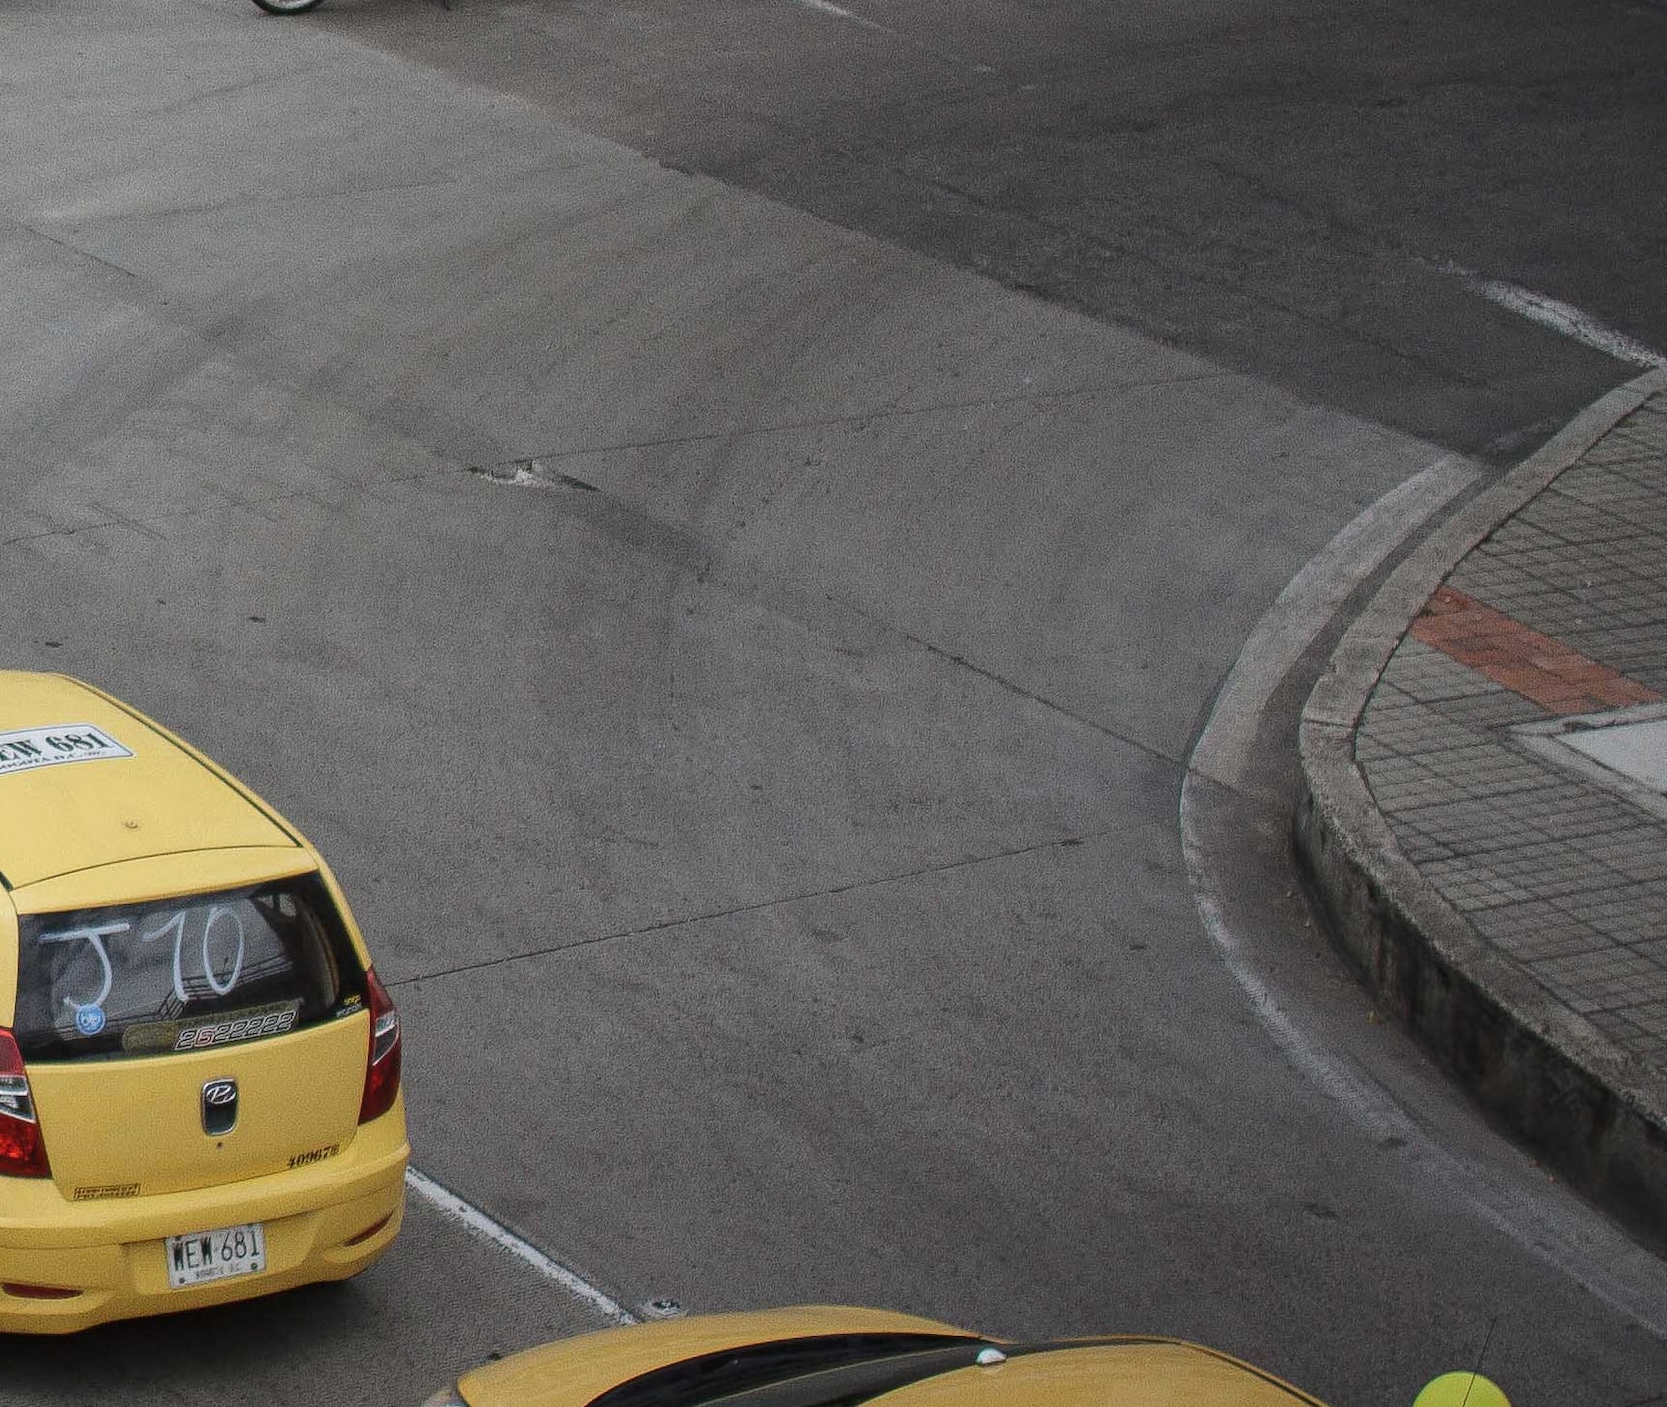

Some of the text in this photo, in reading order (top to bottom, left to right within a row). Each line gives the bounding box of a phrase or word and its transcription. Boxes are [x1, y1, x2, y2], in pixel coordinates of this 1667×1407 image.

[44, 732, 115, 754] 681
[39, 905, 245, 1010] J 10
[172, 1229, 262, 1273] WEW 681
